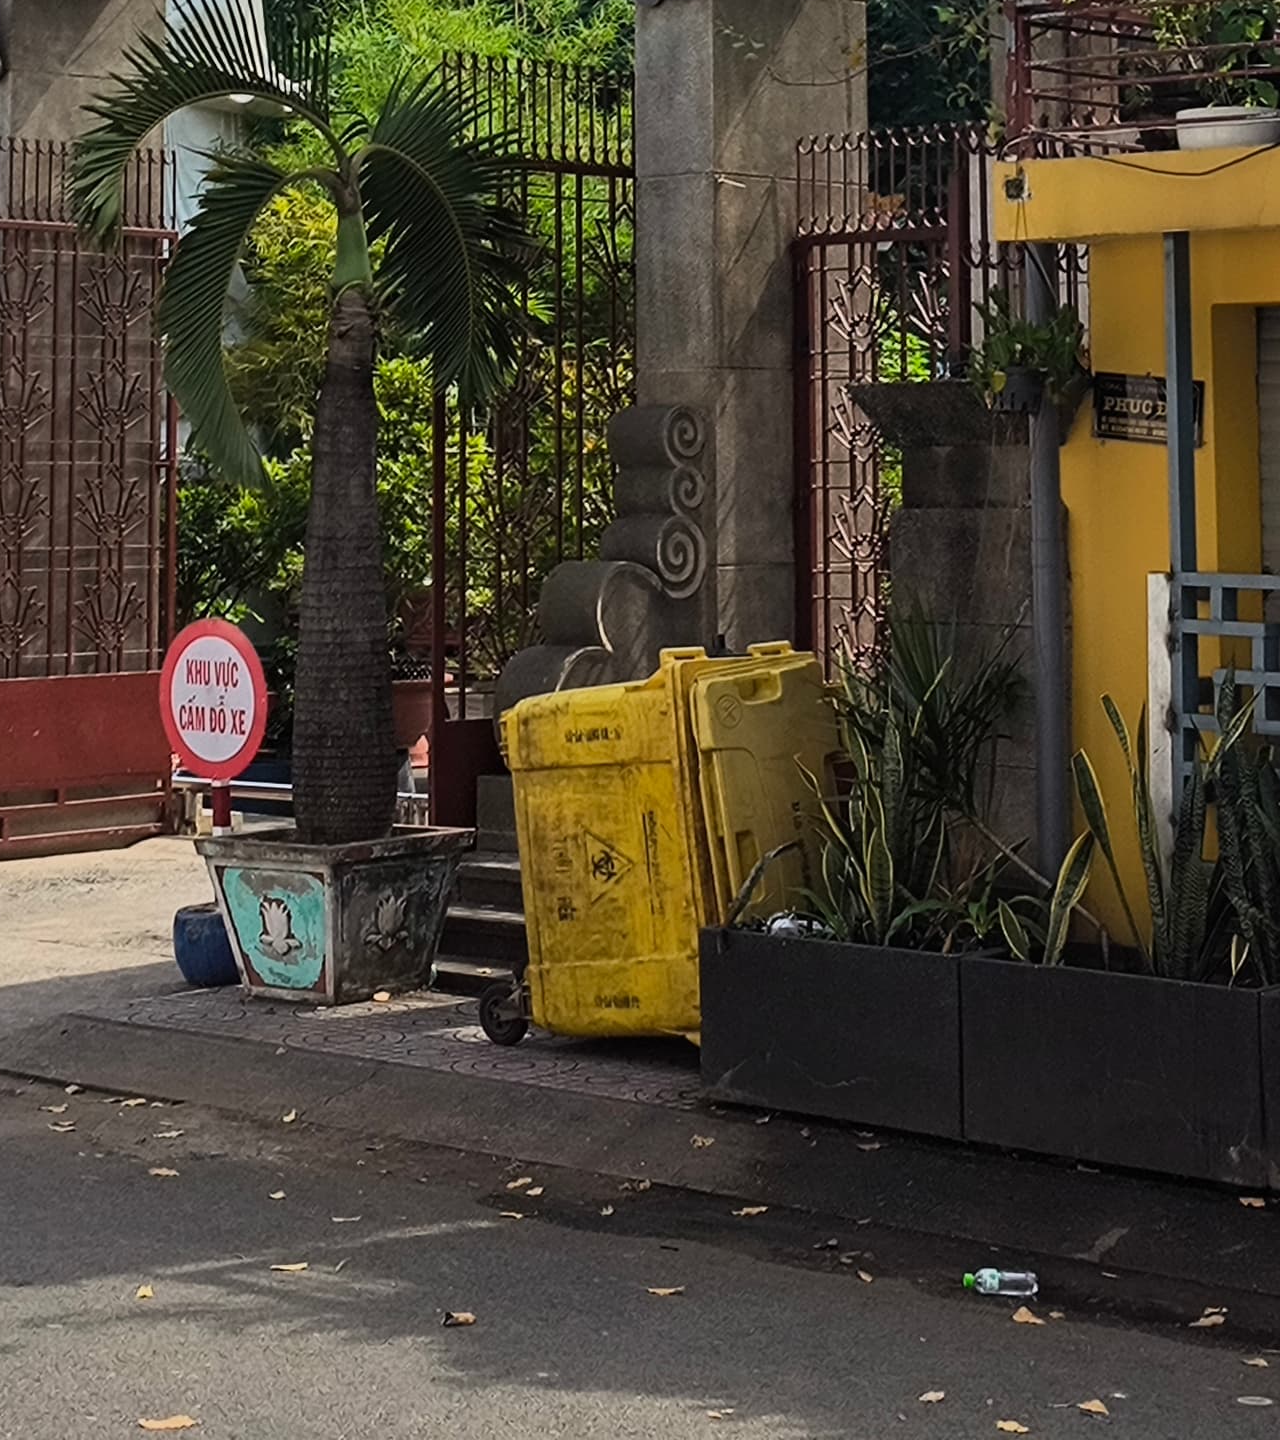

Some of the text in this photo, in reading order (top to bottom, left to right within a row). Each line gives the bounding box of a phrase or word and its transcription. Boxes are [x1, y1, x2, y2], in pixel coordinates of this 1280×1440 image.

[186, 656, 239, 693] KHU VỰC
[230, 708, 246, 736] XE
